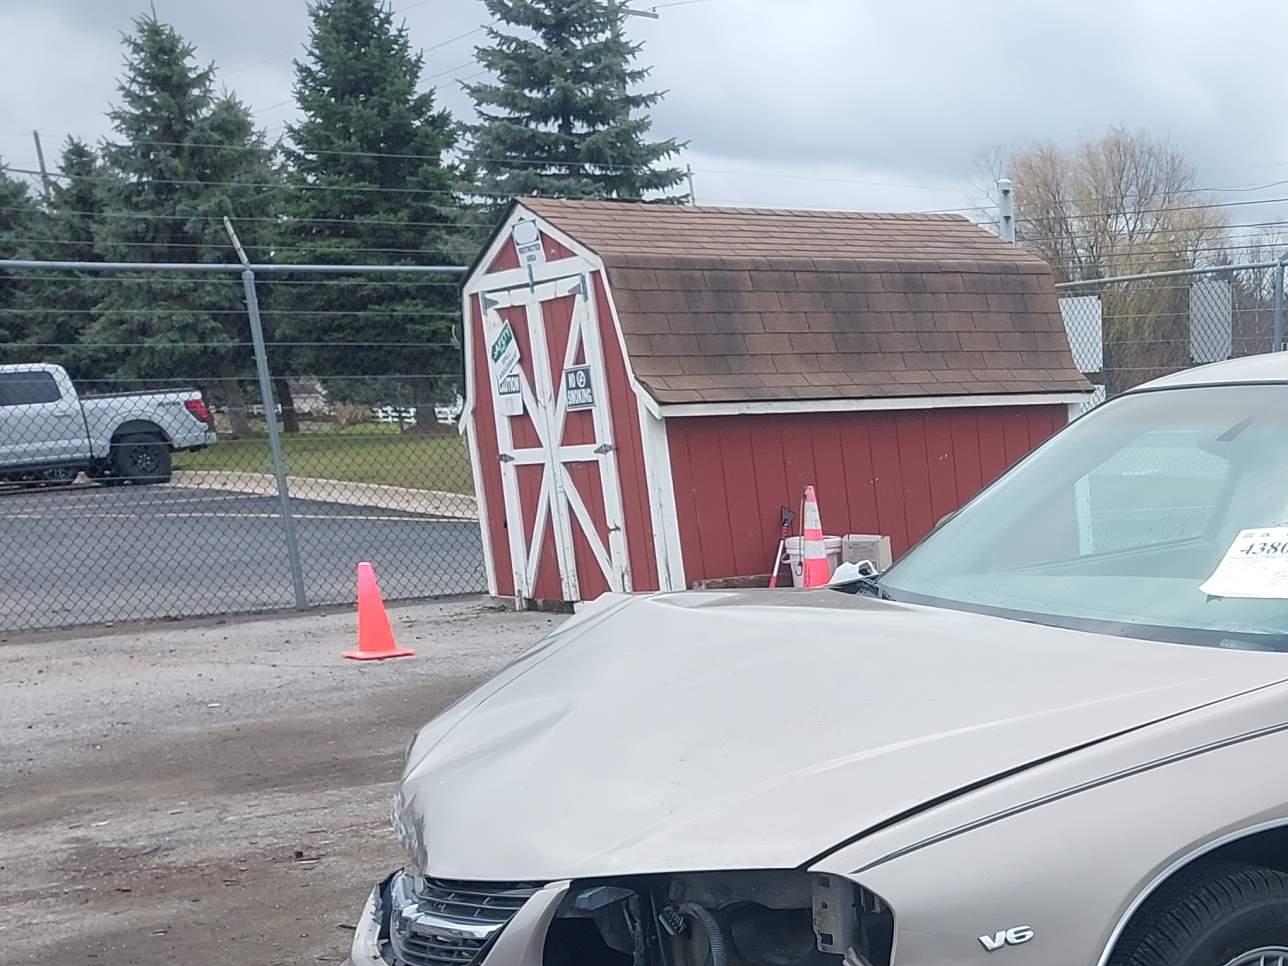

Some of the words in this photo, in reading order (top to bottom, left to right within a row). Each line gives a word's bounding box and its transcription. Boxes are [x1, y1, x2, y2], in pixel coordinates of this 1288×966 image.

[567, 372, 576, 388] NO
[567, 387, 592, 404] SMOKING
[977, 925, 1034, 952] V6
